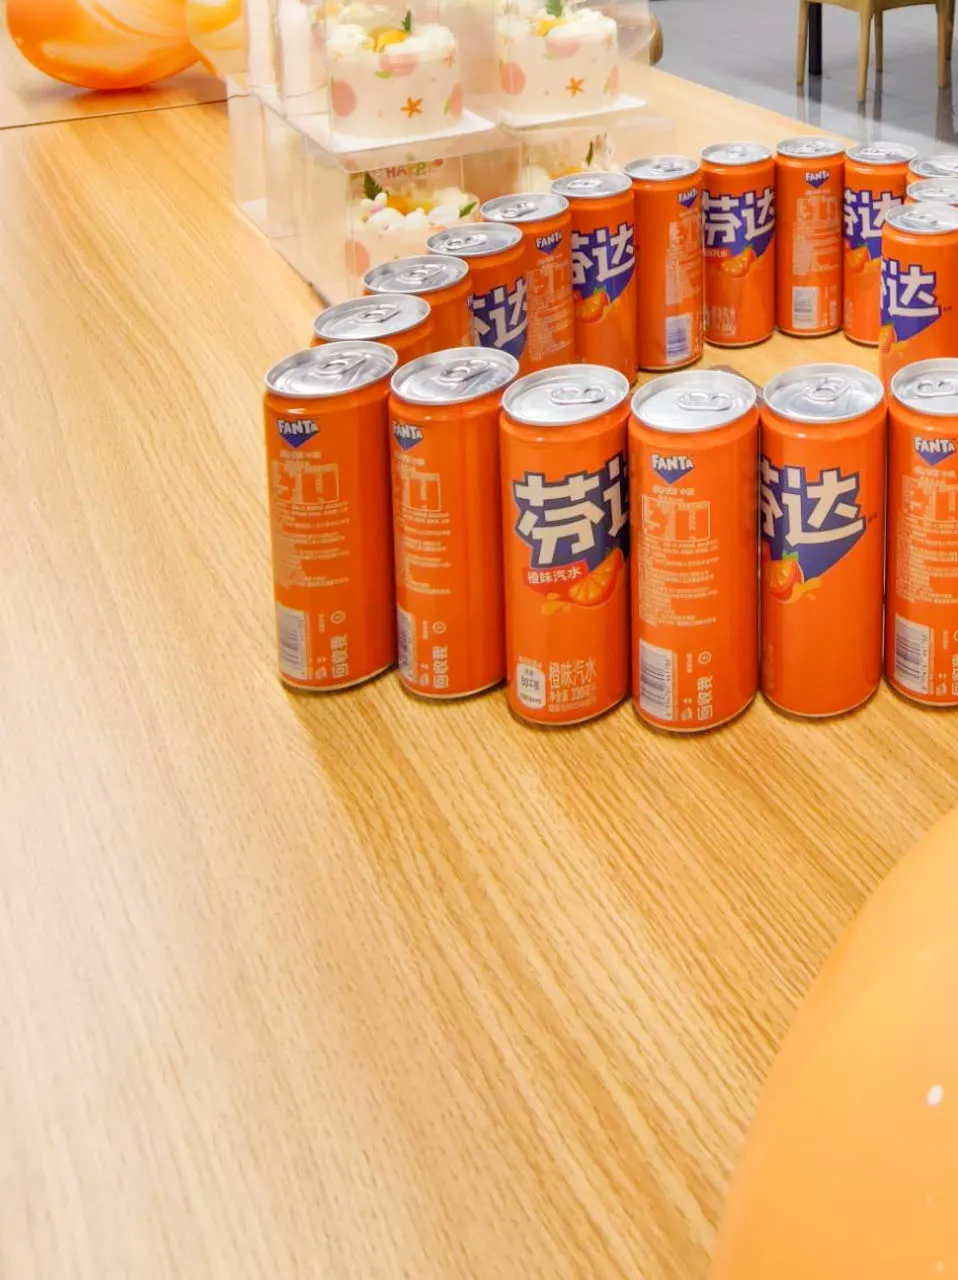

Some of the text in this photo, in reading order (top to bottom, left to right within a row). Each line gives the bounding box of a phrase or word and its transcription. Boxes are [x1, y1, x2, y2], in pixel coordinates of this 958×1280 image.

[878, 259, 940, 318] 达
[277, 419, 319, 435] FANTA
[913, 435, 956, 454] FANTA
[651, 453, 694, 471] FANTA
[527, 567, 582, 585] 橙味汽水
[548, 656, 598, 689] 橙味汽水
